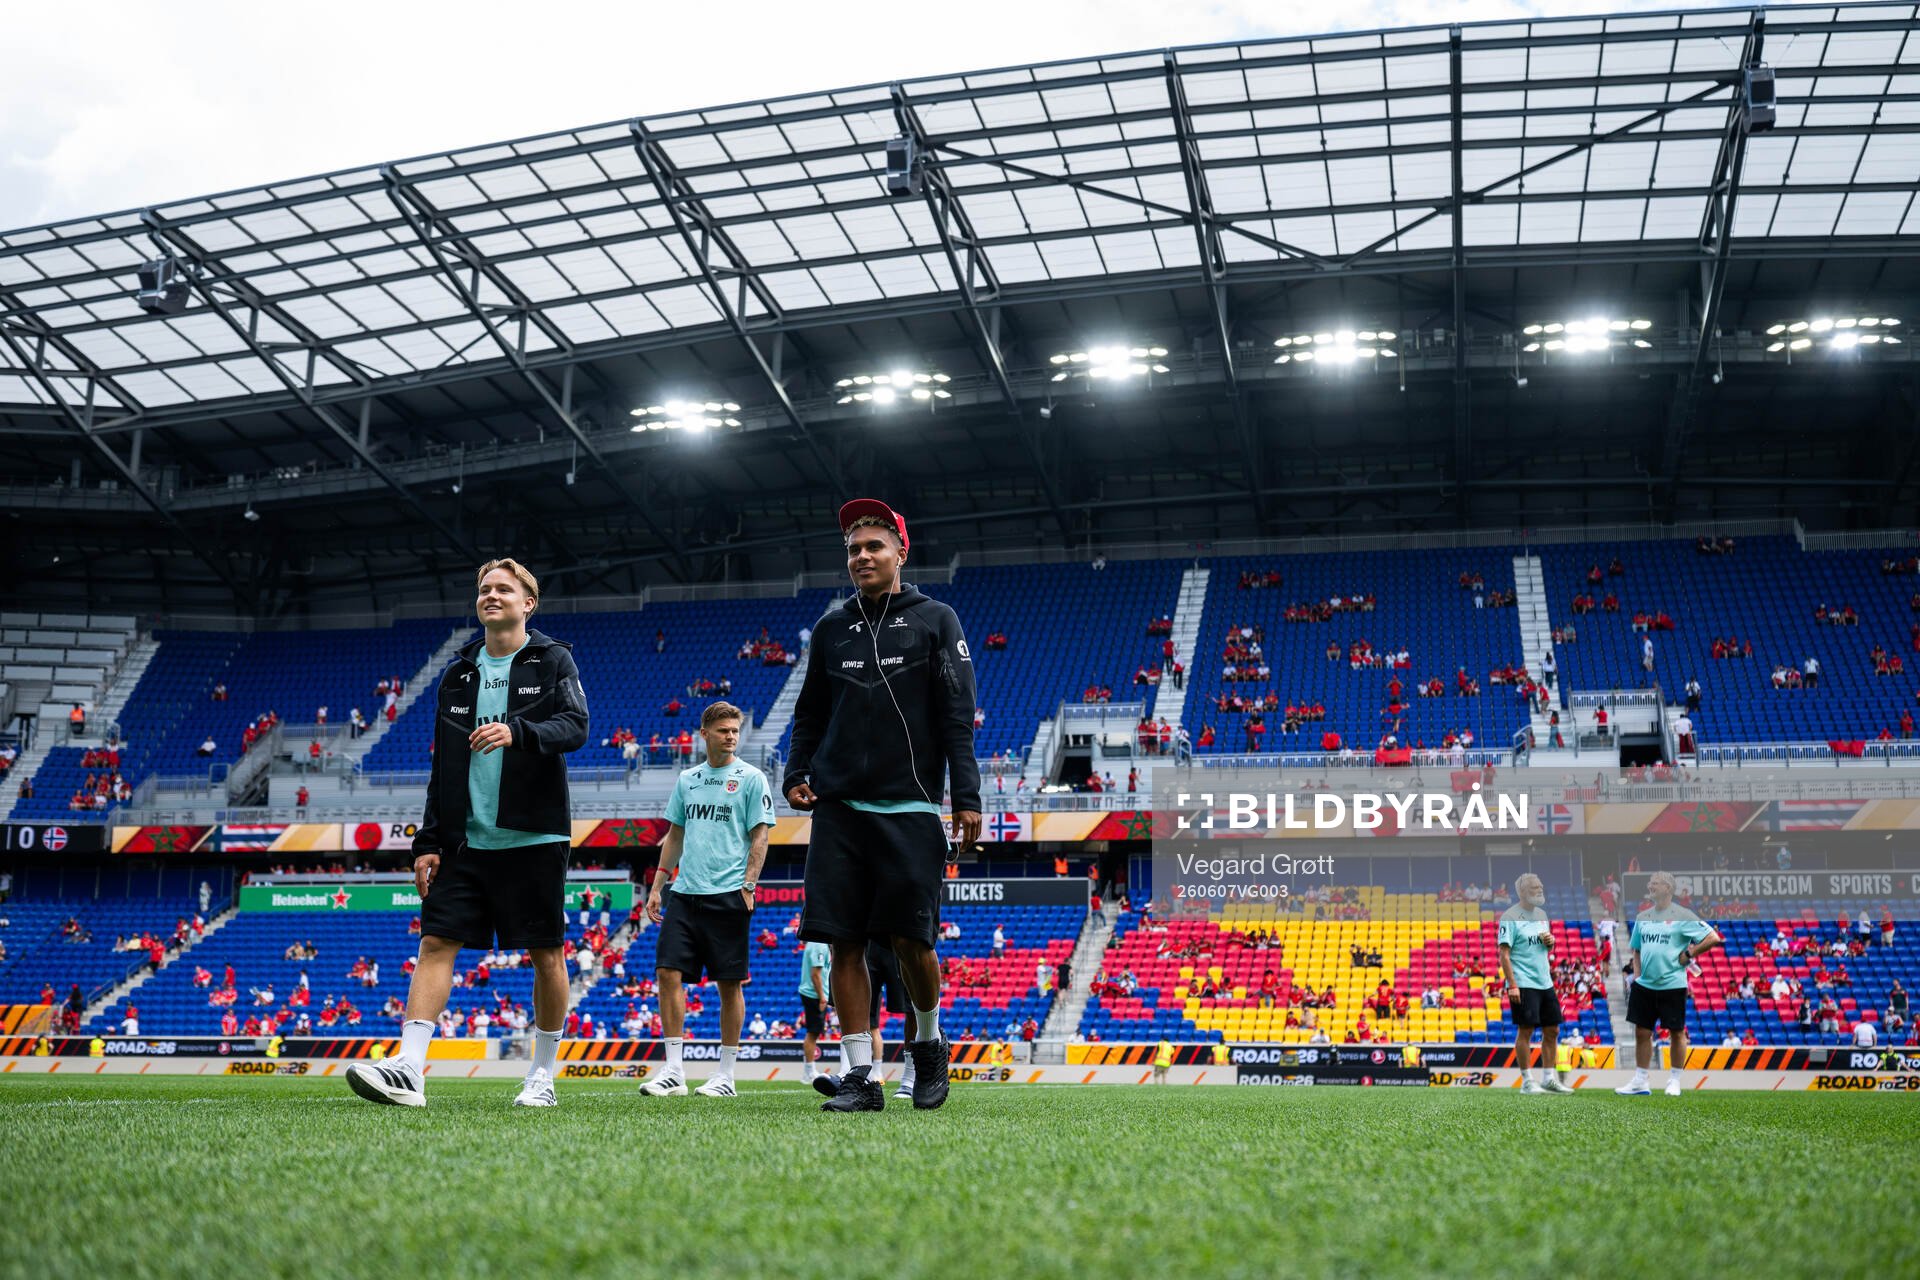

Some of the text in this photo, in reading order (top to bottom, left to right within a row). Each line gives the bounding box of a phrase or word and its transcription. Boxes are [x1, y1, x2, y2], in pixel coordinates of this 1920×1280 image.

[518, 687, 534, 695] KIWI
[686, 803, 715, 820] KIWI
[717, 805, 733, 813] mini
[715, 814, 730, 822] pris
[18, 826, 35, 849] 0
[1830, 875, 1892, 895] SPORTS
[947, 884, 994, 901] TICKETS
[272, 893, 328, 906] Heineken
[1642, 934, 1660, 943] KIWI
[105, 1041, 148, 1054] ROAD
[1232, 1049, 1318, 1063] ROAD 26
[230, 1062, 275, 1074] ROAD
[565, 1065, 613, 1077] ROAD
[627, 1065, 648, 1077] 26
[1240, 1075, 1283, 1086] ROAD
[1469, 1072, 1493, 1085] 26
[1817, 1075, 1876, 1089] ROAD
[1895, 1075, 1920, 1089] 26
